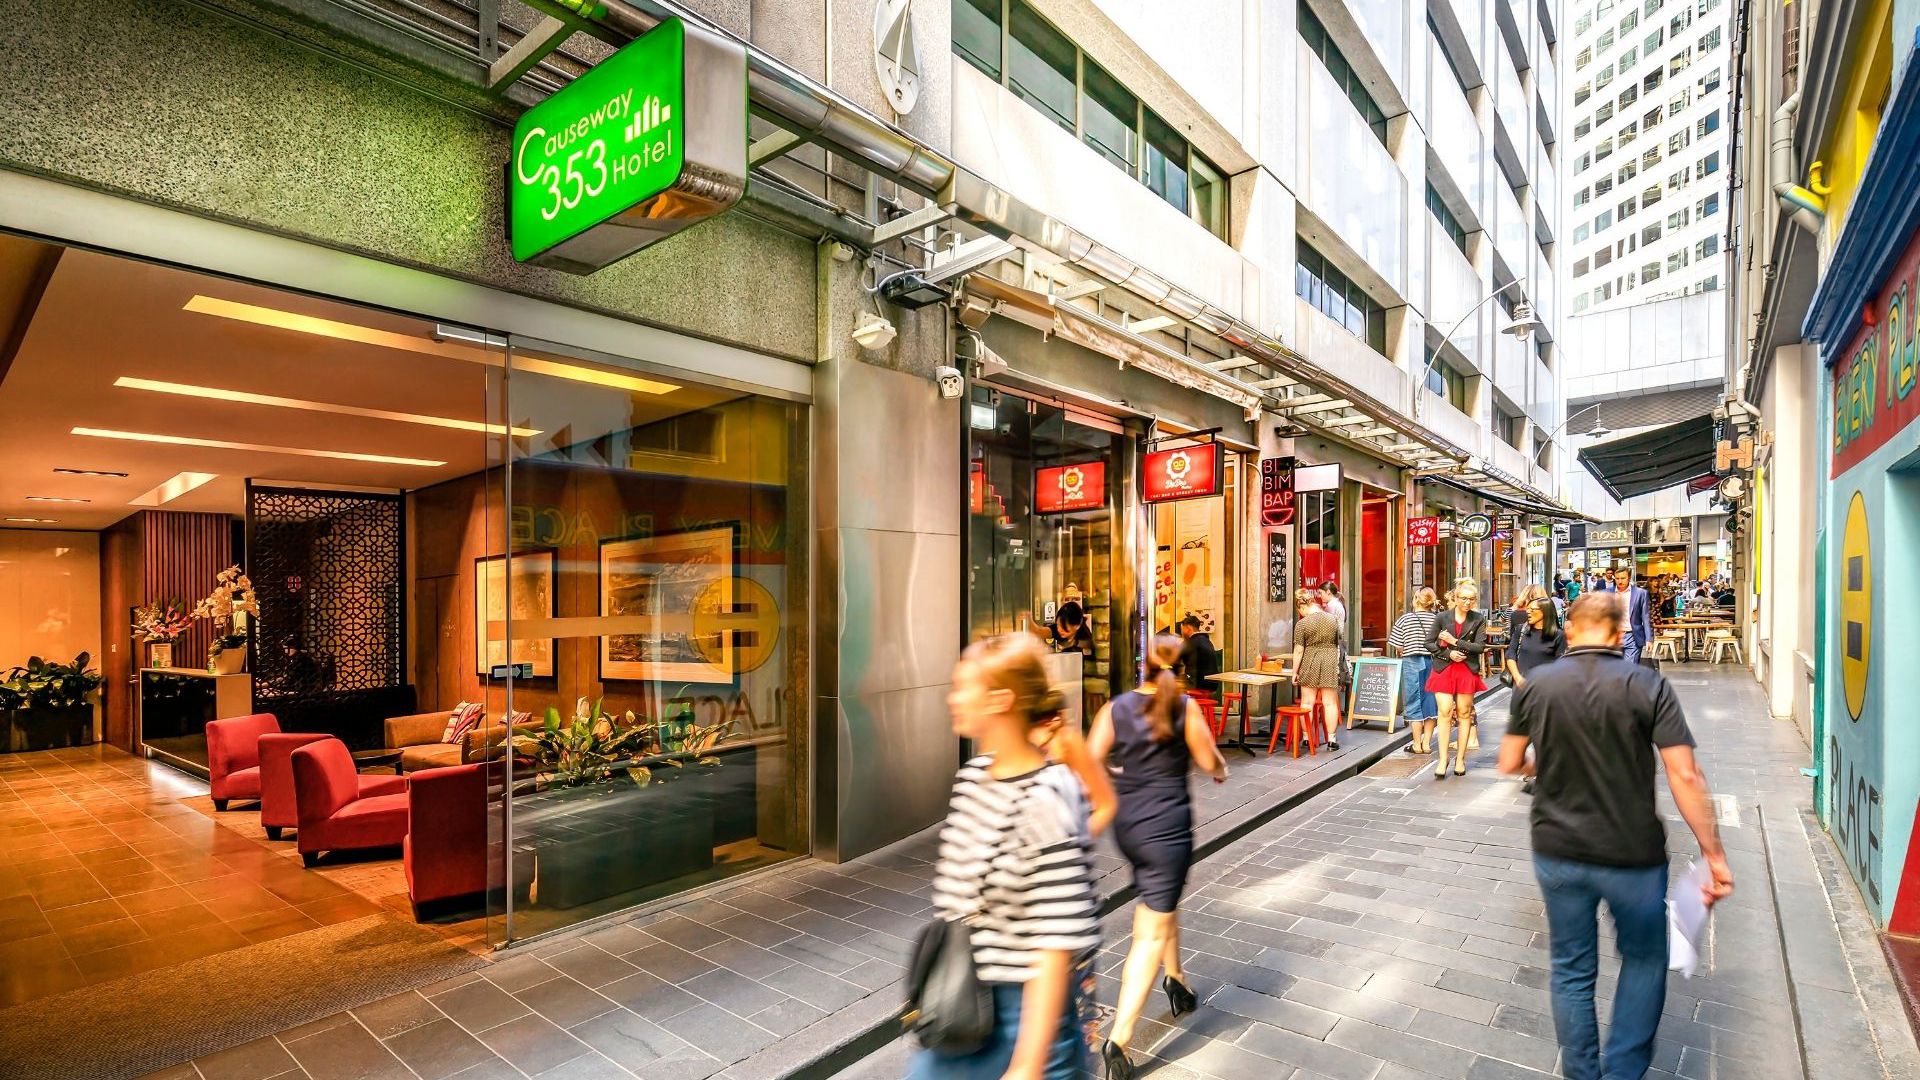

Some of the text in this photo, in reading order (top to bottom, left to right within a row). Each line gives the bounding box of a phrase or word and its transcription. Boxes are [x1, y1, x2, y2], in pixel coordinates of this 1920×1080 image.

[517, 88, 633, 185] Causeway
[541, 129, 672, 221] 353 Hotel
[1836, 320, 1882, 455] EVERY
[1263, 459, 1277, 473] BI
[1264, 474, 1292, 490] BIM
[1264, 491, 1293, 507] BAP
[1409, 518, 1436, 529] SUSHI
[1590, 526, 1628, 540] nosh
[1831, 735, 1880, 905] PLACE
